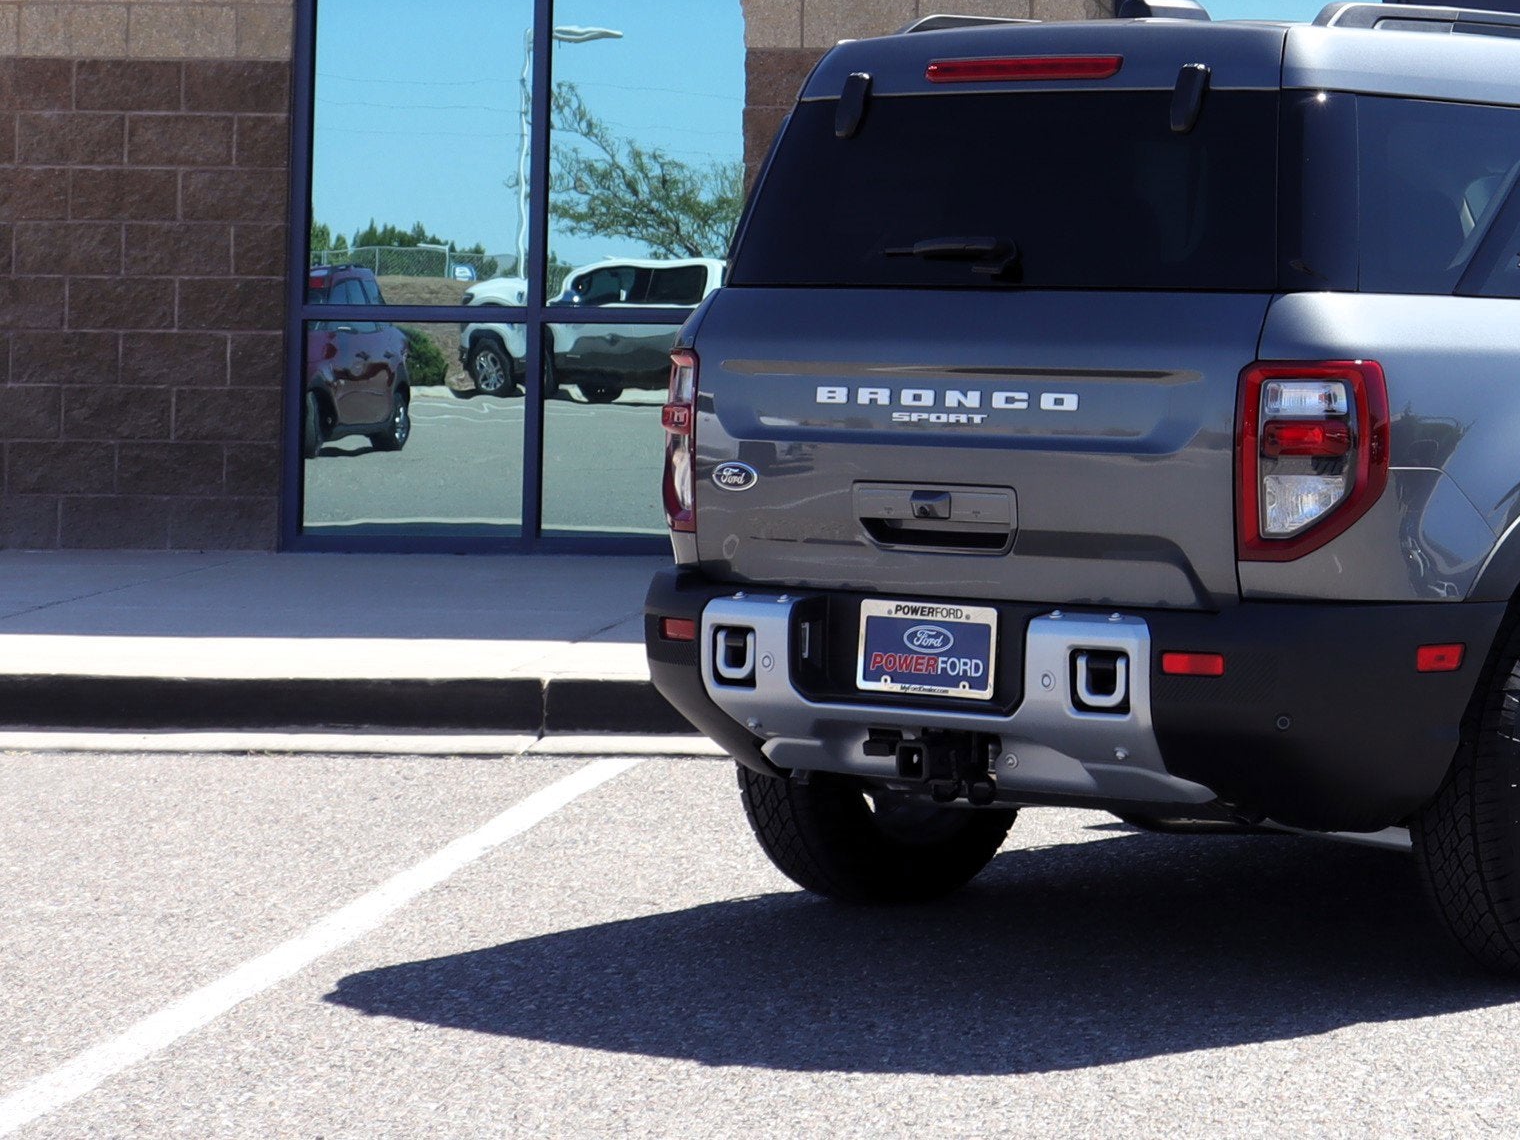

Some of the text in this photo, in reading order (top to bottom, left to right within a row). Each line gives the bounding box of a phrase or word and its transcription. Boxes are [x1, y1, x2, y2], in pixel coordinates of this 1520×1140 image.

[815, 386, 1080, 412] BRONCO
[891, 411, 989, 425] SPORT
[720, 467, 746, 485] Ford
[894, 604, 964, 620] POWERFORD
[913, 629, 944, 648] Ford
[869, 651, 984, 678] POWERFORD
